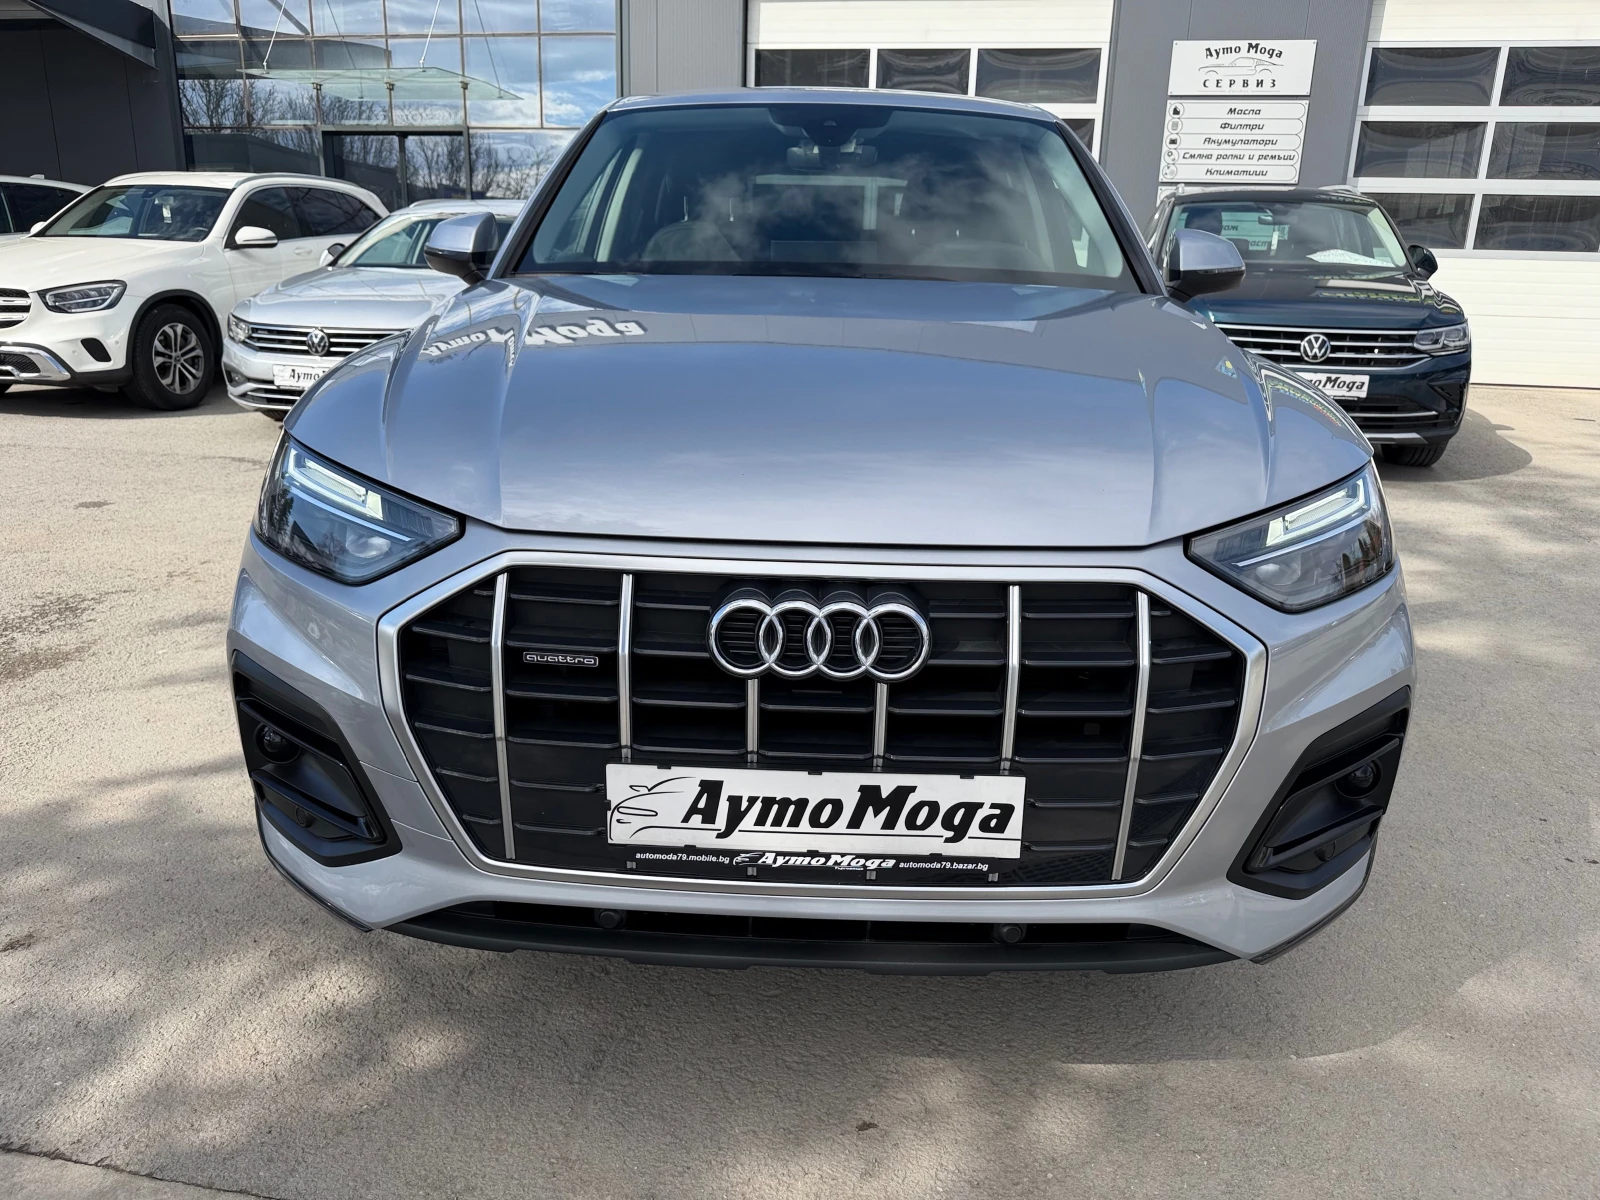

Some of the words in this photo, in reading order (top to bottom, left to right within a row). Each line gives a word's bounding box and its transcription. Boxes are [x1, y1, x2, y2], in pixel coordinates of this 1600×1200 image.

[1205, 45, 1241, 59] Ауто
[1247, 42, 1283, 59] Мода
[1202, 79, 1276, 88] СЕРВИЗ
[1226, 107, 1262, 116] Масла
[1219, 122, 1265, 132] Филтри
[1203, 137, 1278, 148] Акумулатори
[1182, 152, 1213, 160] Смяна
[1215, 152, 1245, 162] ролки
[526, 654, 595, 664] quattro
[635, 852, 730, 864] automoda79.mobile.bg
[898, 861, 989, 871] automoda79.bazar.bg
